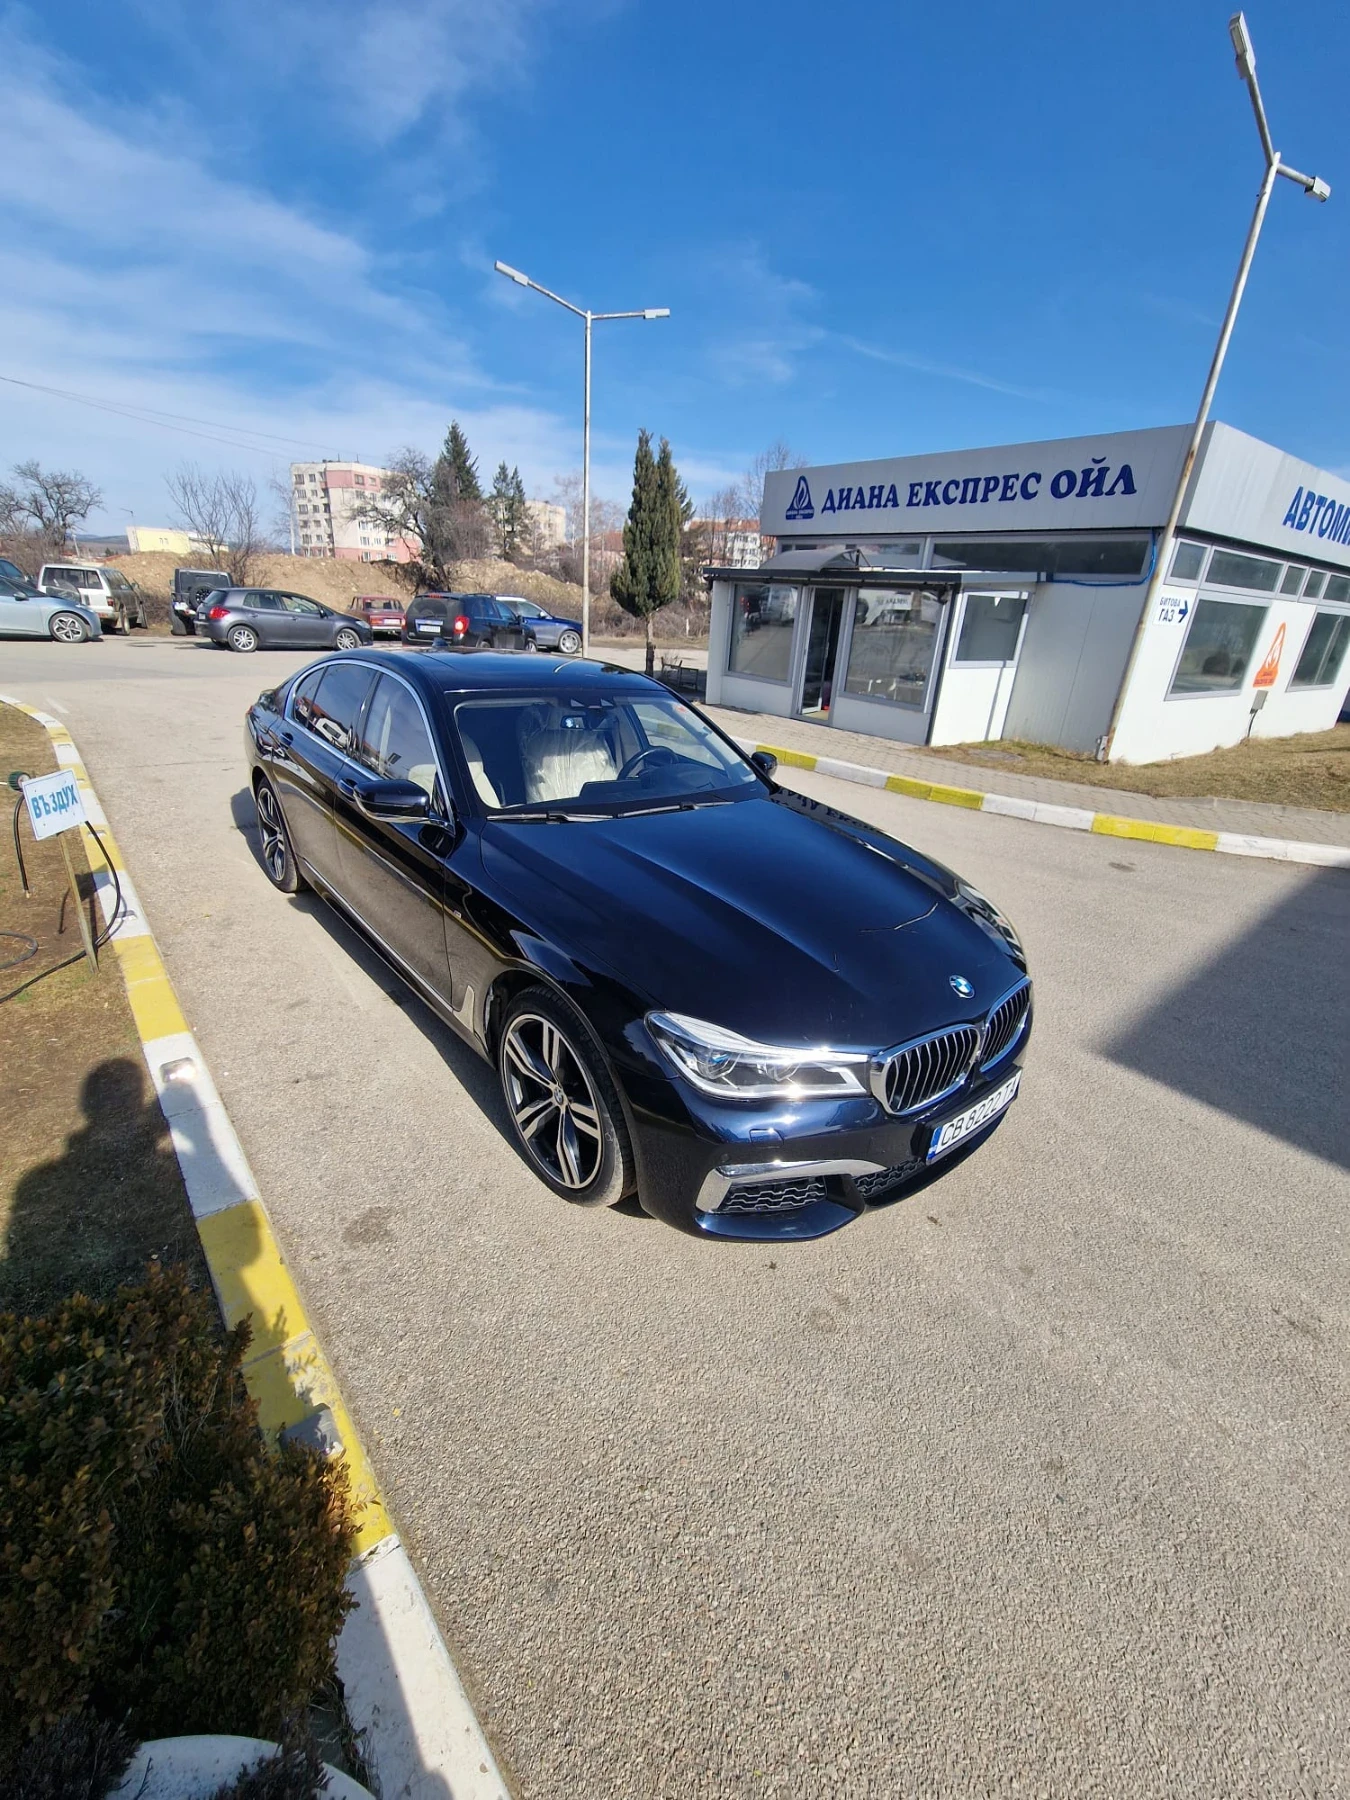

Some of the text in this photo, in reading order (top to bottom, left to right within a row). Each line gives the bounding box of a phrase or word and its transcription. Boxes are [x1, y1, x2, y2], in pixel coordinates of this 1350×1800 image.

[821, 457, 1137, 514] ДИАНА ЕКСПРЕС ОЙЛ
[1159, 608, 1175, 622] ГАЗ
[31, 784, 78, 819] ВЪЗДУХ
[941, 1117, 965, 1146] CB
[965, 1091, 1001, 1131] 8222
